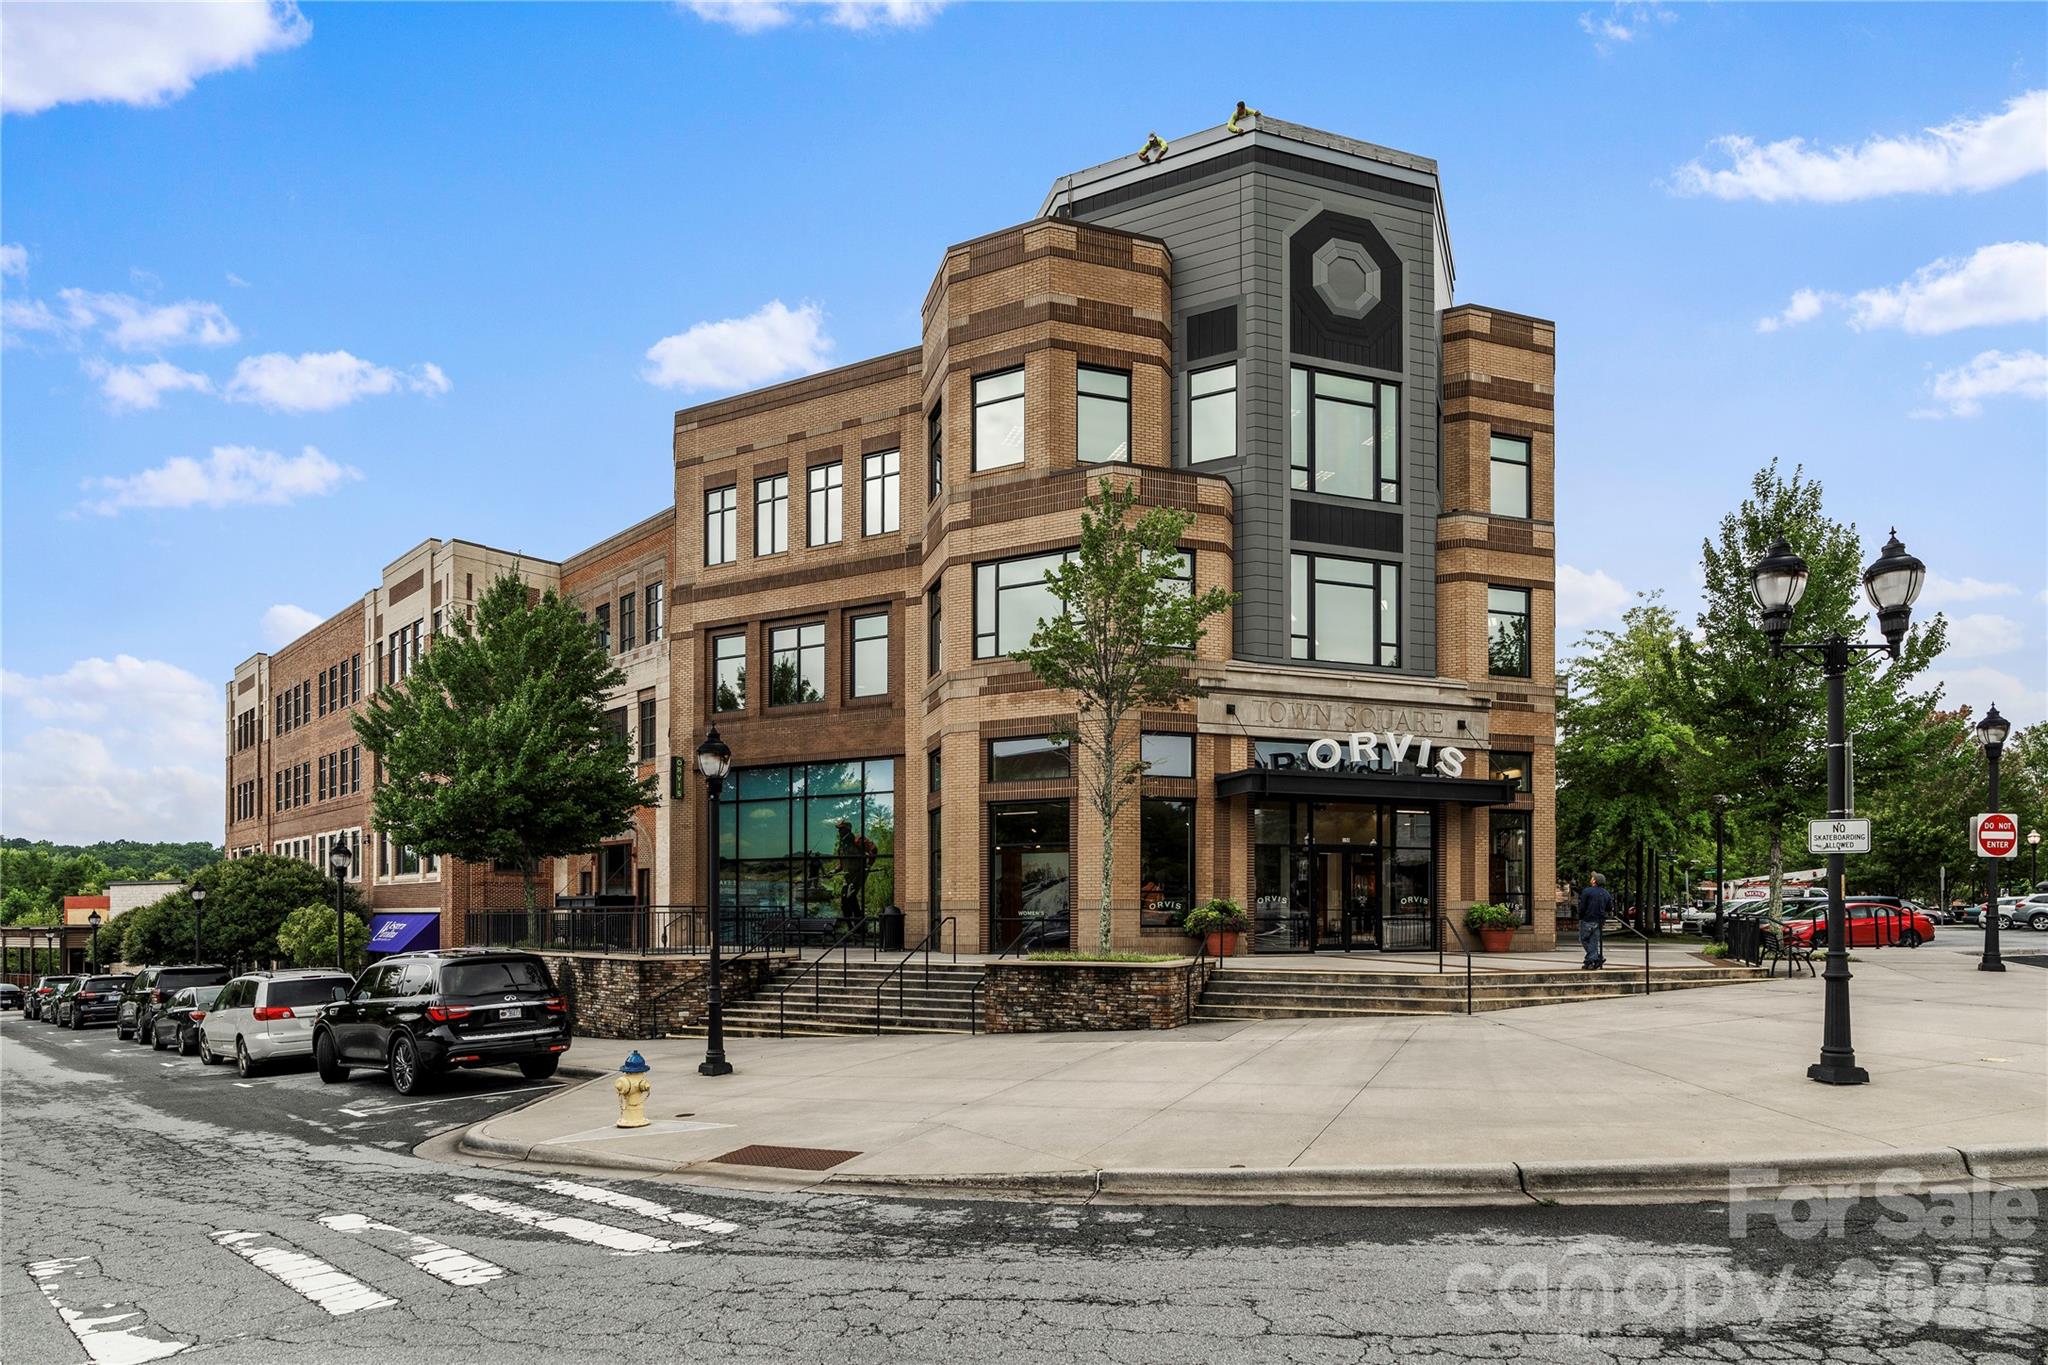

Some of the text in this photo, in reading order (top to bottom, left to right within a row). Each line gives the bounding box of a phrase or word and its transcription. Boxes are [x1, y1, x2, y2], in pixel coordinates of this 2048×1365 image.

[1252, 699, 1444, 734] TOWN SQUARE
[1307, 731, 1468, 779] ORVIS
[1832, 824, 1846, 833] NO
[1813, 833, 1866, 841] SKATEBOARDING
[1824, 841, 1855, 849] ALLOWED
[1986, 840, 2009, 849] ENTER
[1257, 895, 1288, 904] ORVIS
[1401, 896, 1430, 905] ORVIS
[1149, 900, 1182, 910] ORVIS
